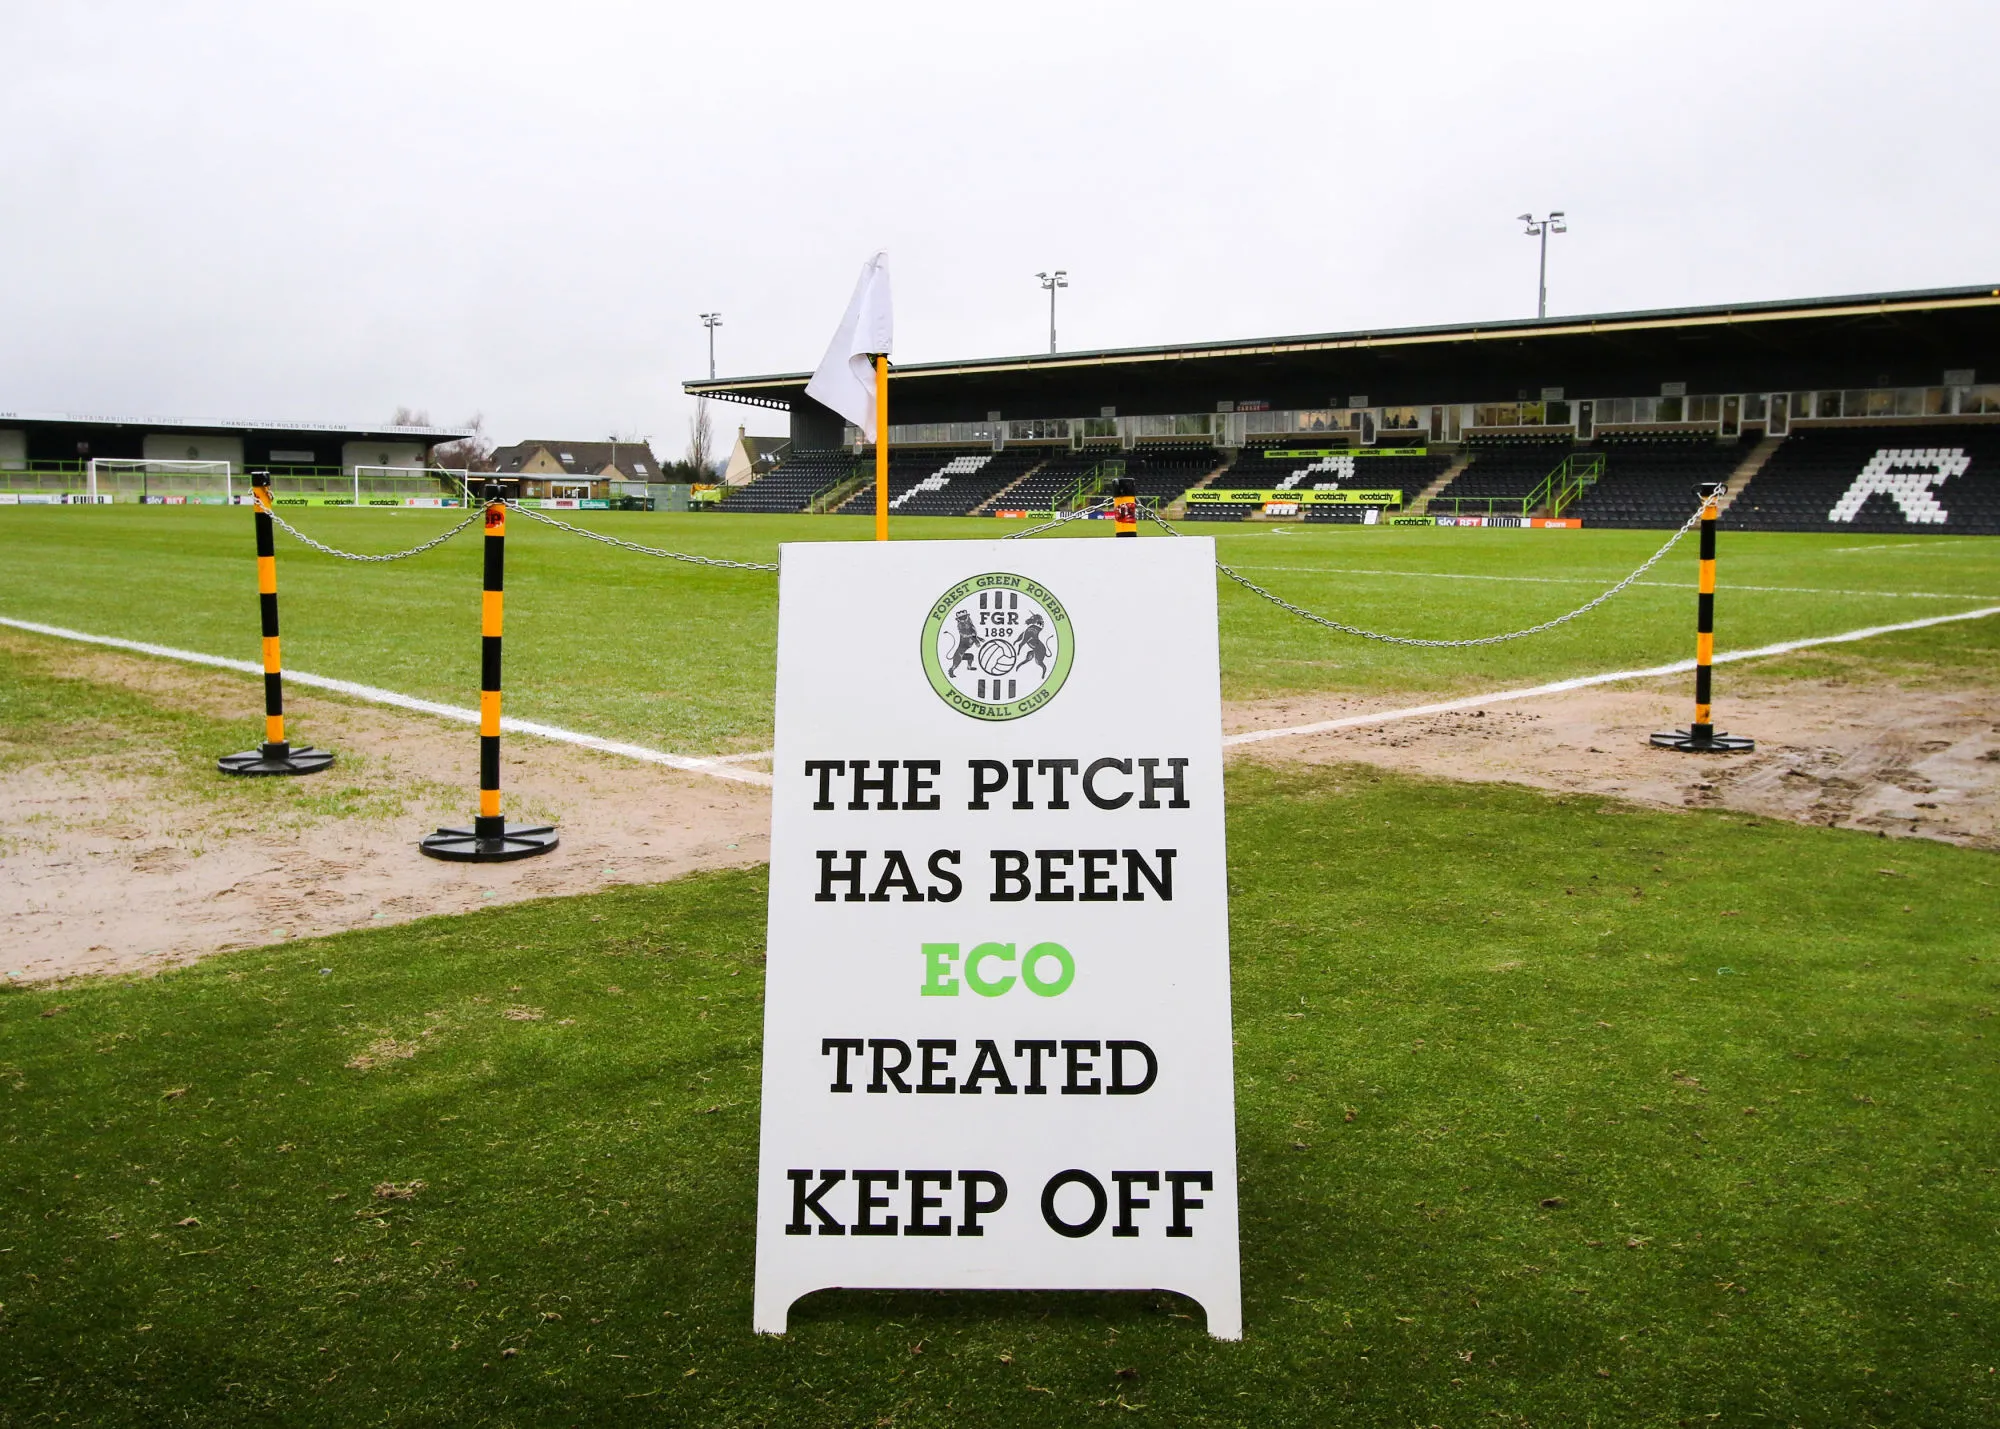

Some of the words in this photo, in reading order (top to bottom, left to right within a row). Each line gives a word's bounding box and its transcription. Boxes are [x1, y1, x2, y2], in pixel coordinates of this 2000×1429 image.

[276, 499, 308, 507] ecotricity
[1192, 492, 1221, 501] ecotricity
[1231, 492, 1261, 501] ecotricity
[1272, 492, 1304, 501] ecotricity
[1315, 492, 1347, 501] ecotricity
[1359, 492, 1394, 502] ecotricity
[1828, 448, 1971, 523] R
[1394, 517, 1431, 527] ecotricity
[1438, 517, 1456, 526] sky
[1459, 518, 1480, 527] BET
[932, 583, 971, 621] FOREST
[976, 576, 1021, 588] GREEN
[1026, 583, 1065, 622] ROVERS
[979, 612, 1019, 625] FGR
[985, 628, 1013, 638] 1889
[945, 689, 1012, 717] FOOTBALL
[1018, 688, 1050, 713] CLUB
[805, 760, 940, 810] THE
[968, 758, 1190, 810] PITCH
[815, 849, 962, 902] HAS
[990, 849, 1177, 901] BEEN
[921, 942, 1075, 997] ECO
[822, 1038, 1158, 1095] TREATED
[785, 1169, 1007, 1236] KEEP
[1041, 1169, 1213, 1238] OFF
